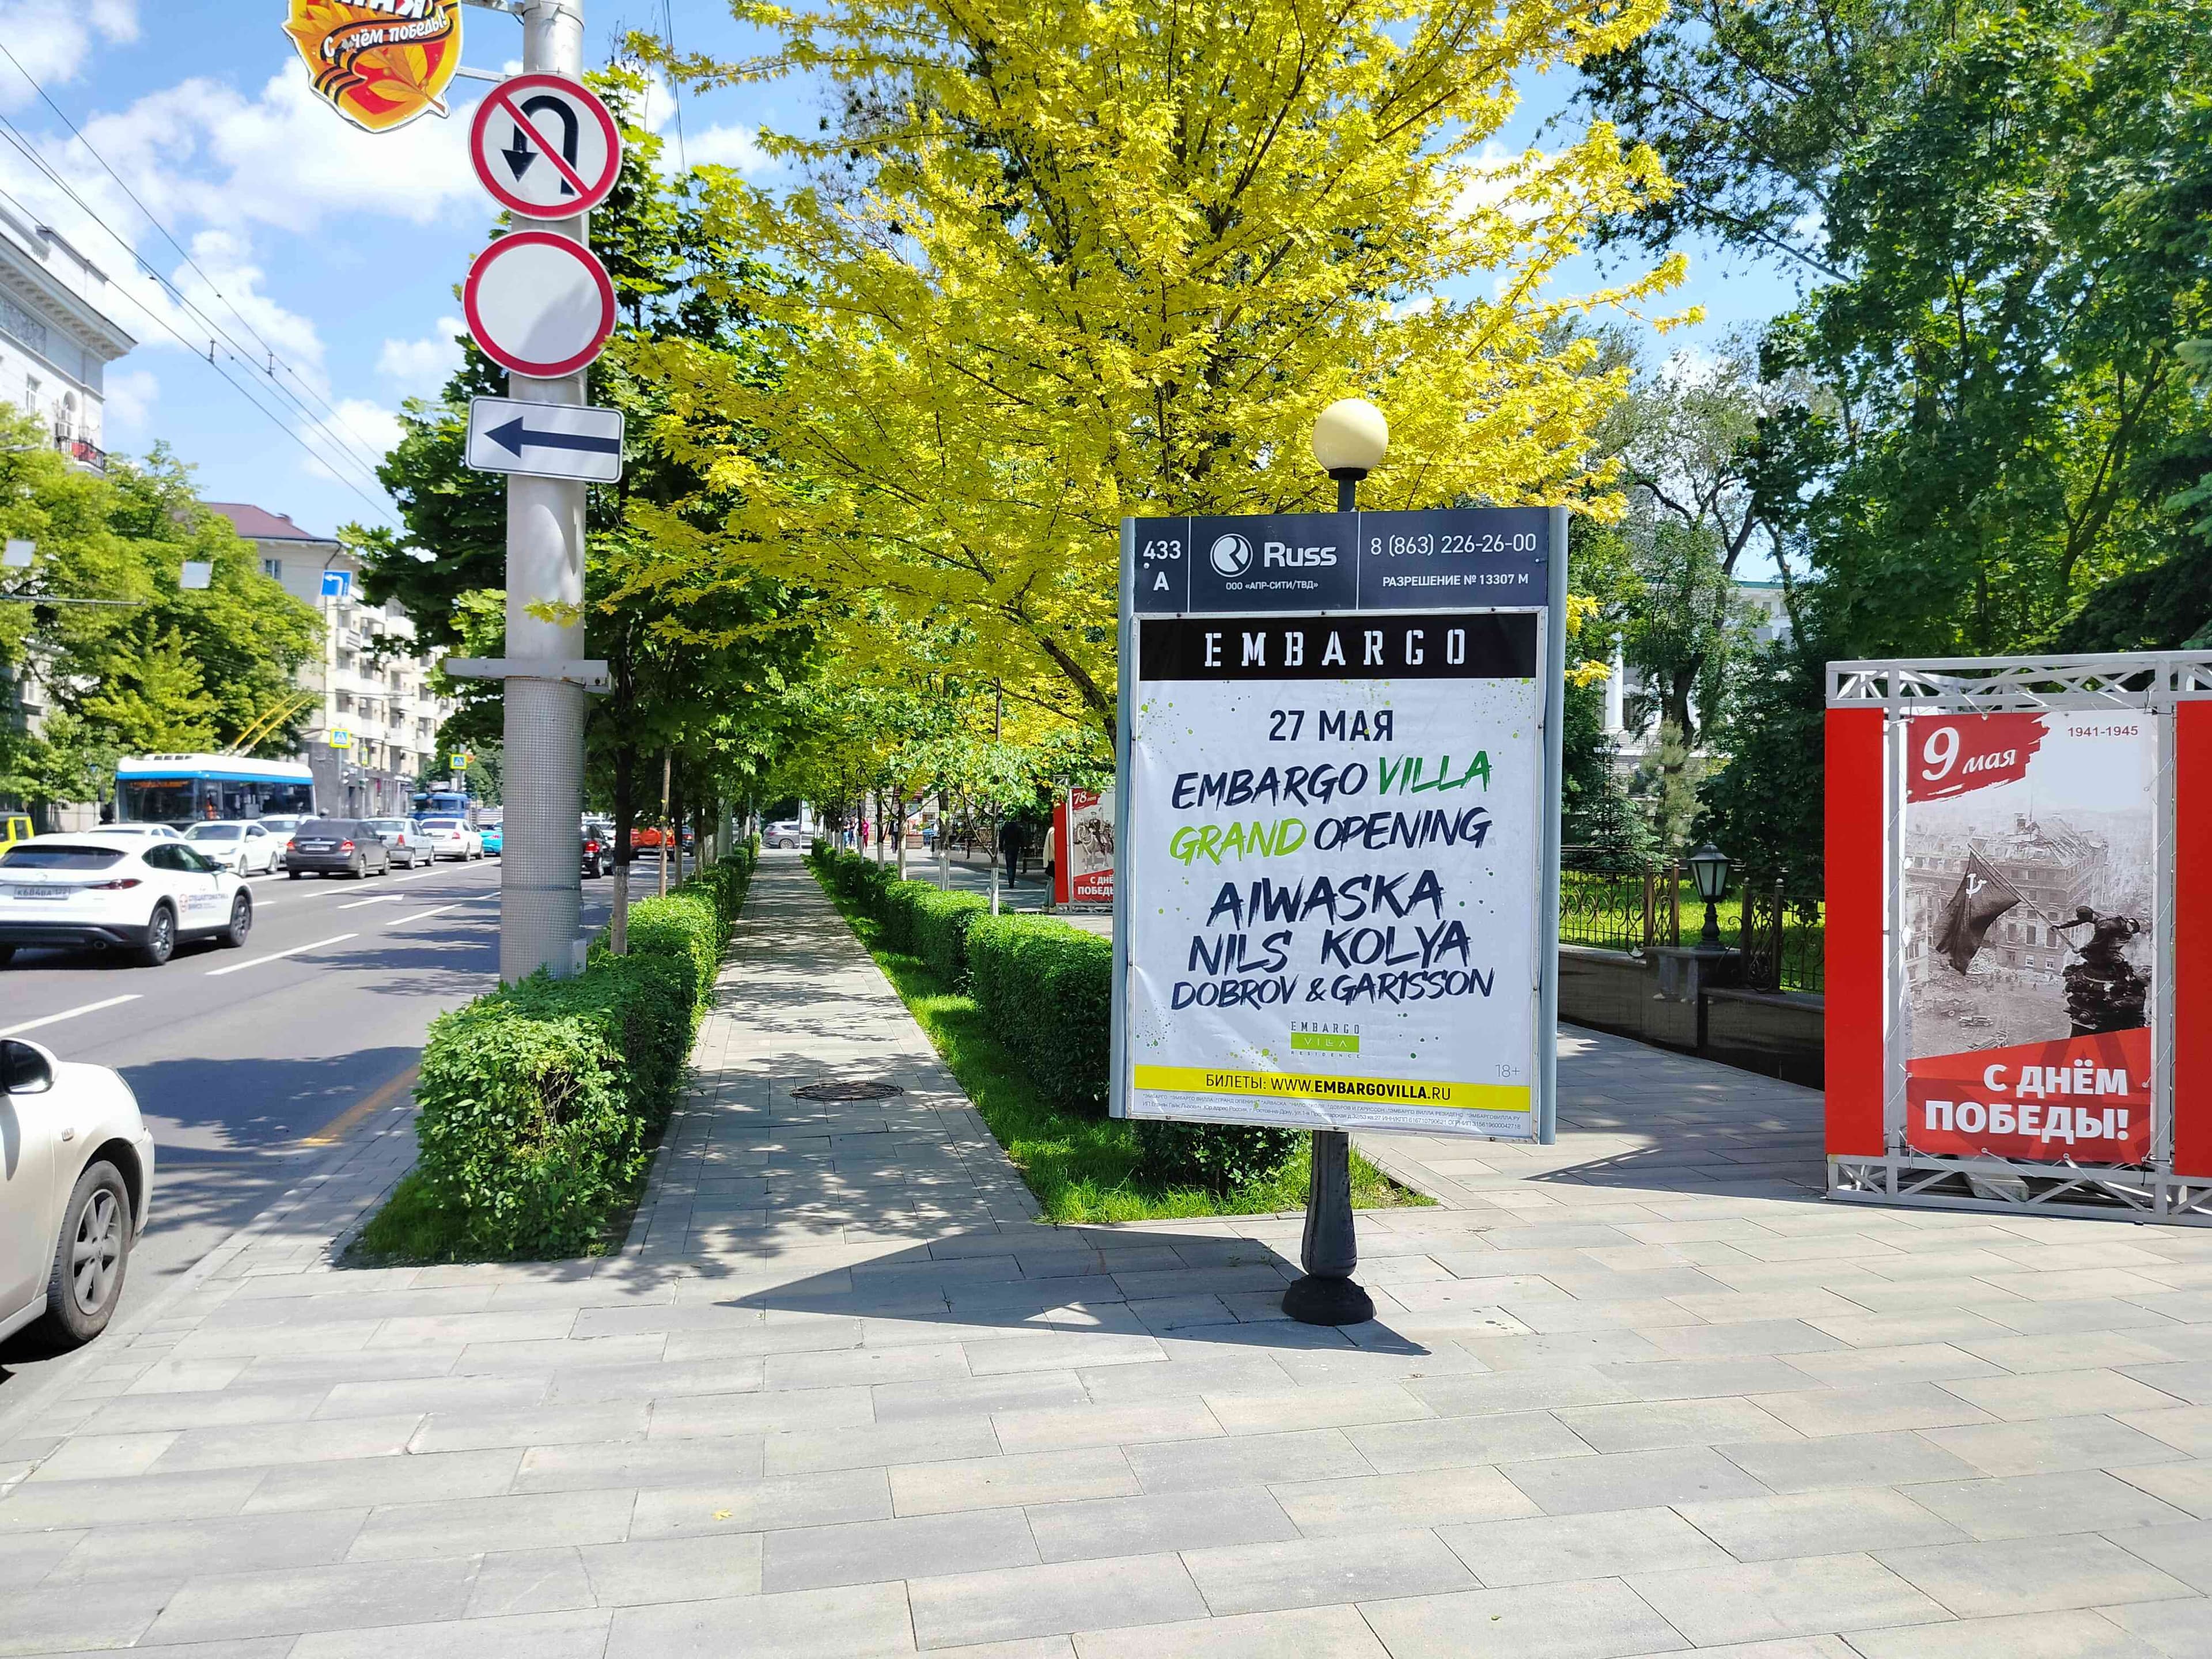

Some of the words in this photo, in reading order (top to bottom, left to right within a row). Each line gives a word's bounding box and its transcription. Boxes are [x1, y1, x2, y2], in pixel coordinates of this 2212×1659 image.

[323, 36, 335, 58] С
[1143, 540, 1181, 560] 433
[1371, 537, 1382, 556] 8
[1388, 534, 1434, 558] (863)
[1441, 533, 1536, 554] 226-26-00
[1153, 571, 1170, 591] А
[1226, 581, 1243, 590] ООО
[1382, 575, 1461, 587] РАЗРЕШЕНИЕ
[1464, 574, 1477, 585] №
[1479, 574, 1515, 585] 13307
[1205, 628, 1465, 667] EMBARGO
[1268, 710, 1305, 741] 27
[1319, 710, 1393, 741] МАЯ
[2067, 724, 2139, 738] 1941-1945
[1922, 726, 1959, 782] 9
[1961, 747, 2016, 775] мая
[1171, 763, 1369, 812] EMBARGO
[1379, 750, 1493, 797] VILLA
[1073, 791, 1087, 805] 78
[1169, 818, 1307, 866] GRAND
[1314, 806, 1493, 852] OPENING
[1090, 876, 1096, 884] С
[1097, 874, 1114, 885] ДНЁ
[1077, 886, 1114, 897] ПОБЕД
[1206, 869, 1447, 930] AIWASKA
[1188, 929, 1293, 976] NILS
[1321, 919, 1474, 969] KOLYA
[1171, 974, 1300, 1010] DOBROV
[1305, 978, 1327, 1002] &
[1331, 967, 1495, 1006] GARISSON
[1291, 1021, 1359, 1034] EMBARGO
[1304, 1037, 1347, 1047] VILLA
[1291, 1051, 1360, 1059] RESIDENCE
[1495, 1064, 1521, 1078] 18+
[1983, 1064, 2006, 1091] С
[2017, 1058, 2129, 1101] ДНЁМ
[1205, 1073, 1267, 1091] БИЛЕТЫ:
[1271, 1077, 1451, 1101] WWW.EMBARGOVILLA.RU
[1925, 1099, 2130, 1145] ПОБЕДЫ!
